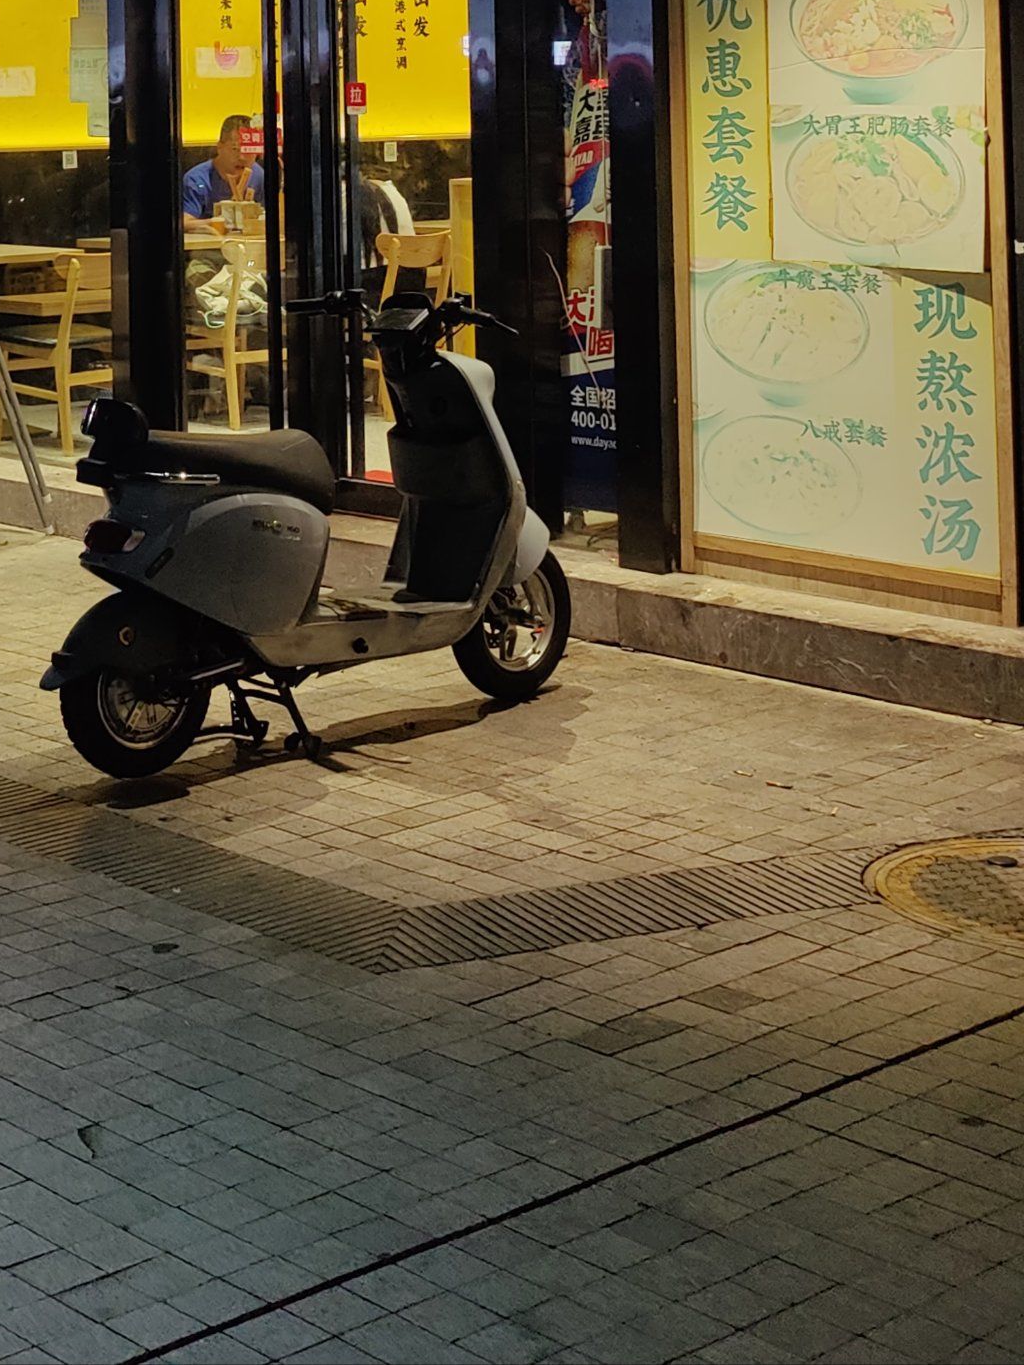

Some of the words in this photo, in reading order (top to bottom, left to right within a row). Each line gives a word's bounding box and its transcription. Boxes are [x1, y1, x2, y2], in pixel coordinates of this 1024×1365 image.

[350, 86, 363, 103] 拉
[803, 114, 955, 138] 大胃王肥肠套餐
[775, 269, 883, 295] 牛魔王套餐
[566, 289, 595, 323] 大
[570, 385, 616, 410] 全国招
[570, 410, 617, 431] 400-01
[801, 419, 888, 447] 八戒套餐
[913, 282, 982, 562] 现熬浓汤
